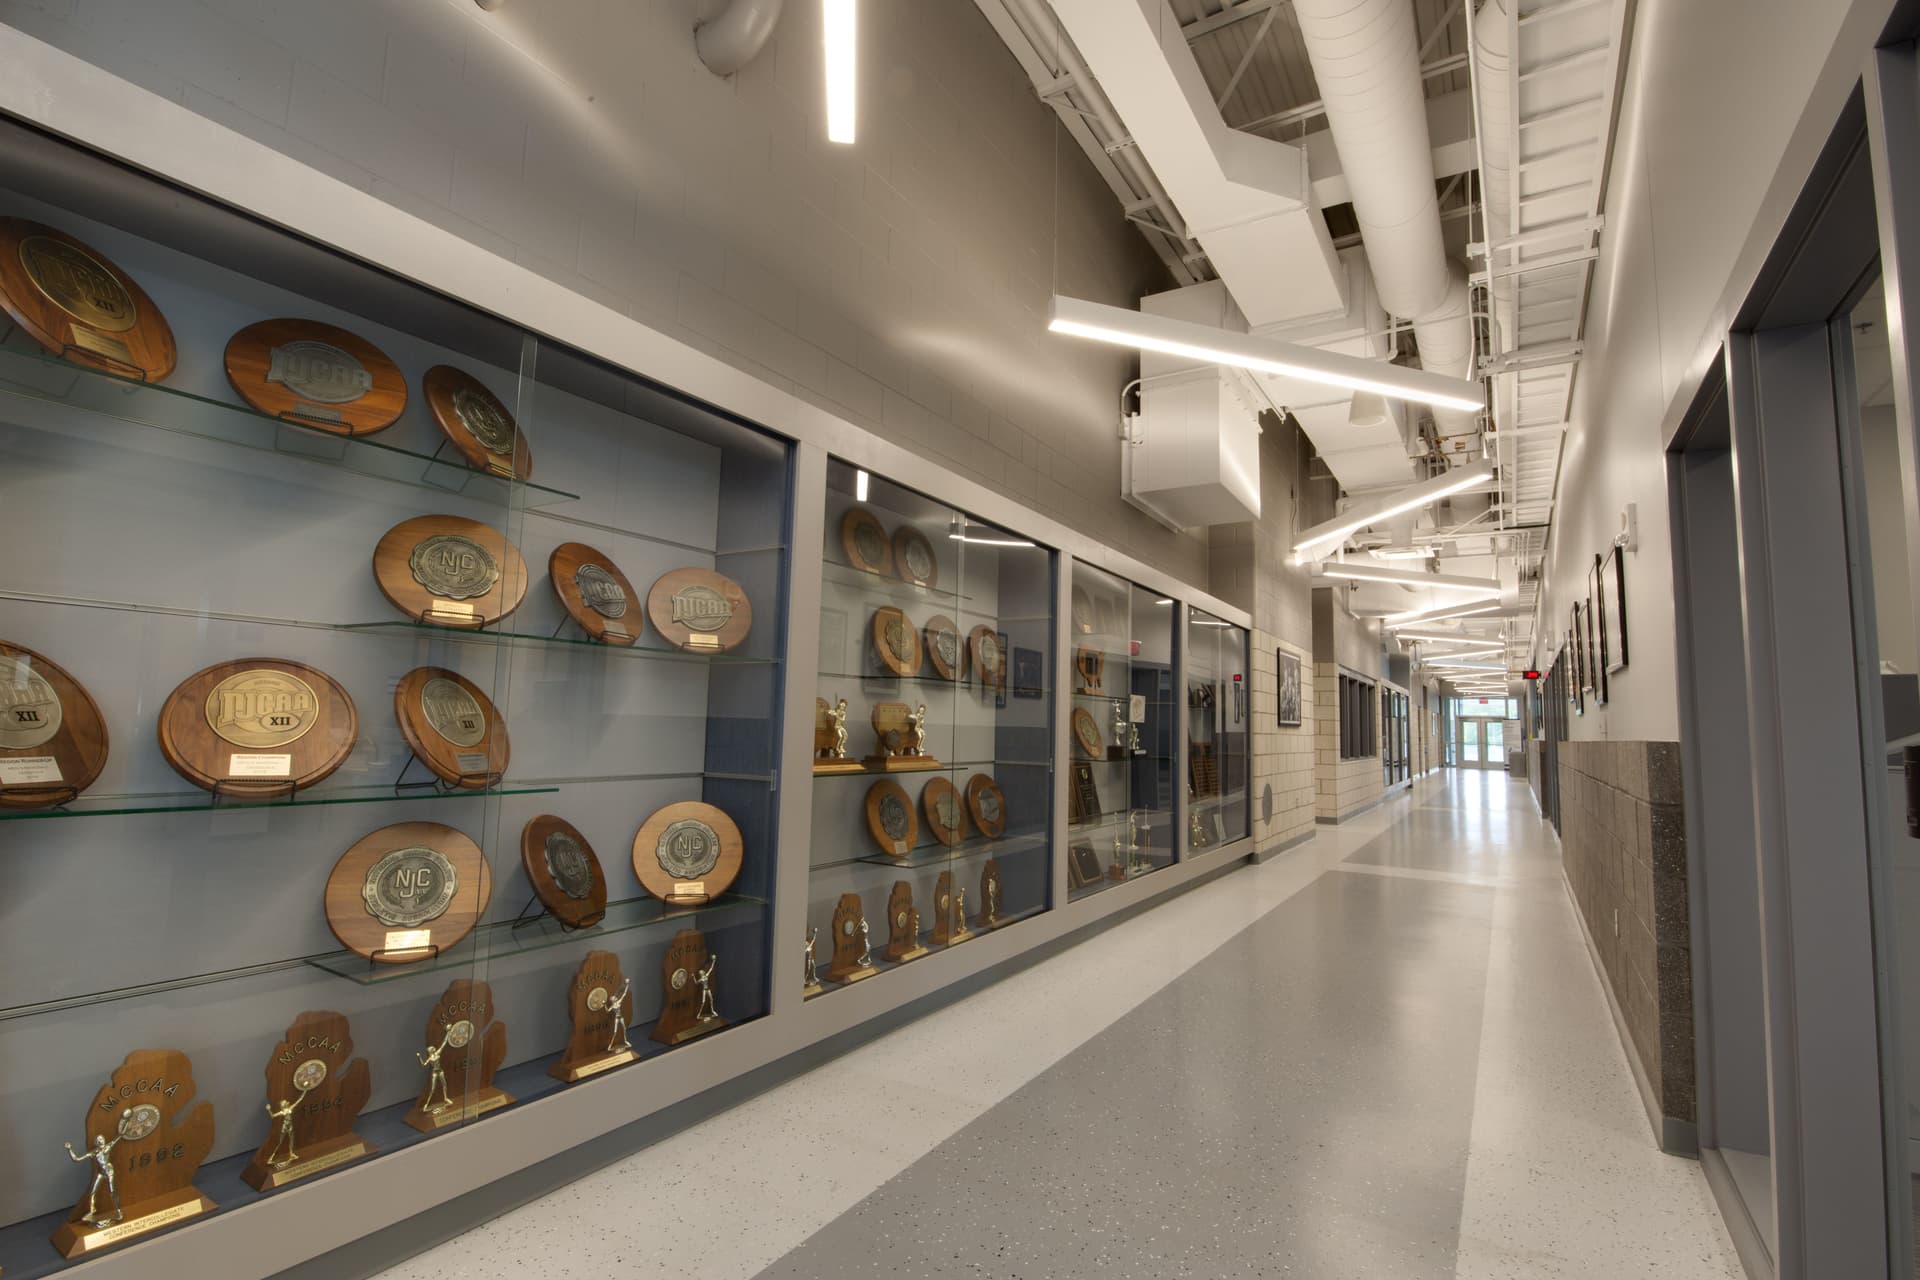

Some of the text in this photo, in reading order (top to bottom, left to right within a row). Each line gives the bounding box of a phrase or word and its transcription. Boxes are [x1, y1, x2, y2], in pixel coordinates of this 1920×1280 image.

[441, 551, 474, 575] NJC
[15, 710, 40, 721] XII
[218, 690, 312, 727] NJCAA
[270, 716, 290, 726] XII
[462, 720, 475, 729] XII
[677, 836, 702, 858] NJC
[395, 868, 431, 898] NJC
[279, 1036, 341, 1065] MCCAA
[100, 1078, 181, 1113] MCCAA
